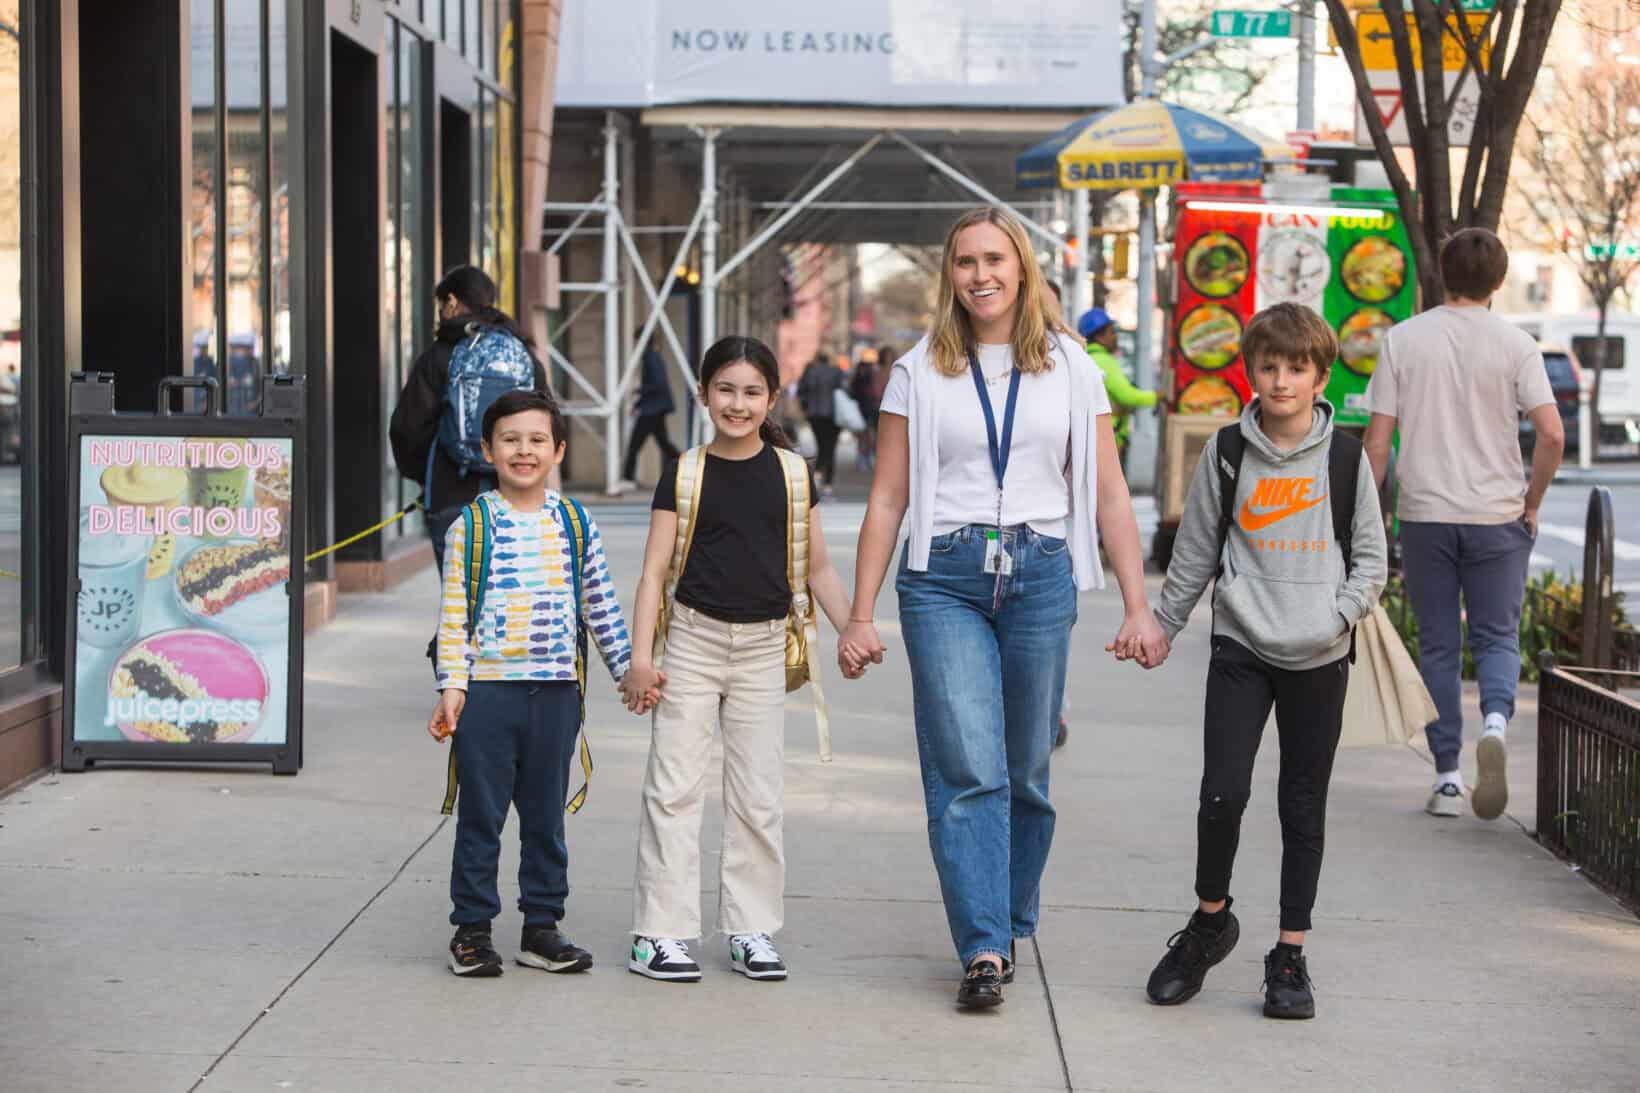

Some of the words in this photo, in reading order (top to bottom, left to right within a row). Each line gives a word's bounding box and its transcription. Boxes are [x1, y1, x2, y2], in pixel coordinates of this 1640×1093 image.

[1242, 13, 1269, 35] 77
[671, 29, 749, 52] NOW
[764, 29, 897, 54] LEASING
[1067, 160, 1178, 182] SABRETT
[90, 439, 282, 469] NUTRITIOUS
[1250, 477, 1316, 507] NIKE
[88, 504, 282, 537] DELICIOUS
[103, 689, 260, 728] juicepress
